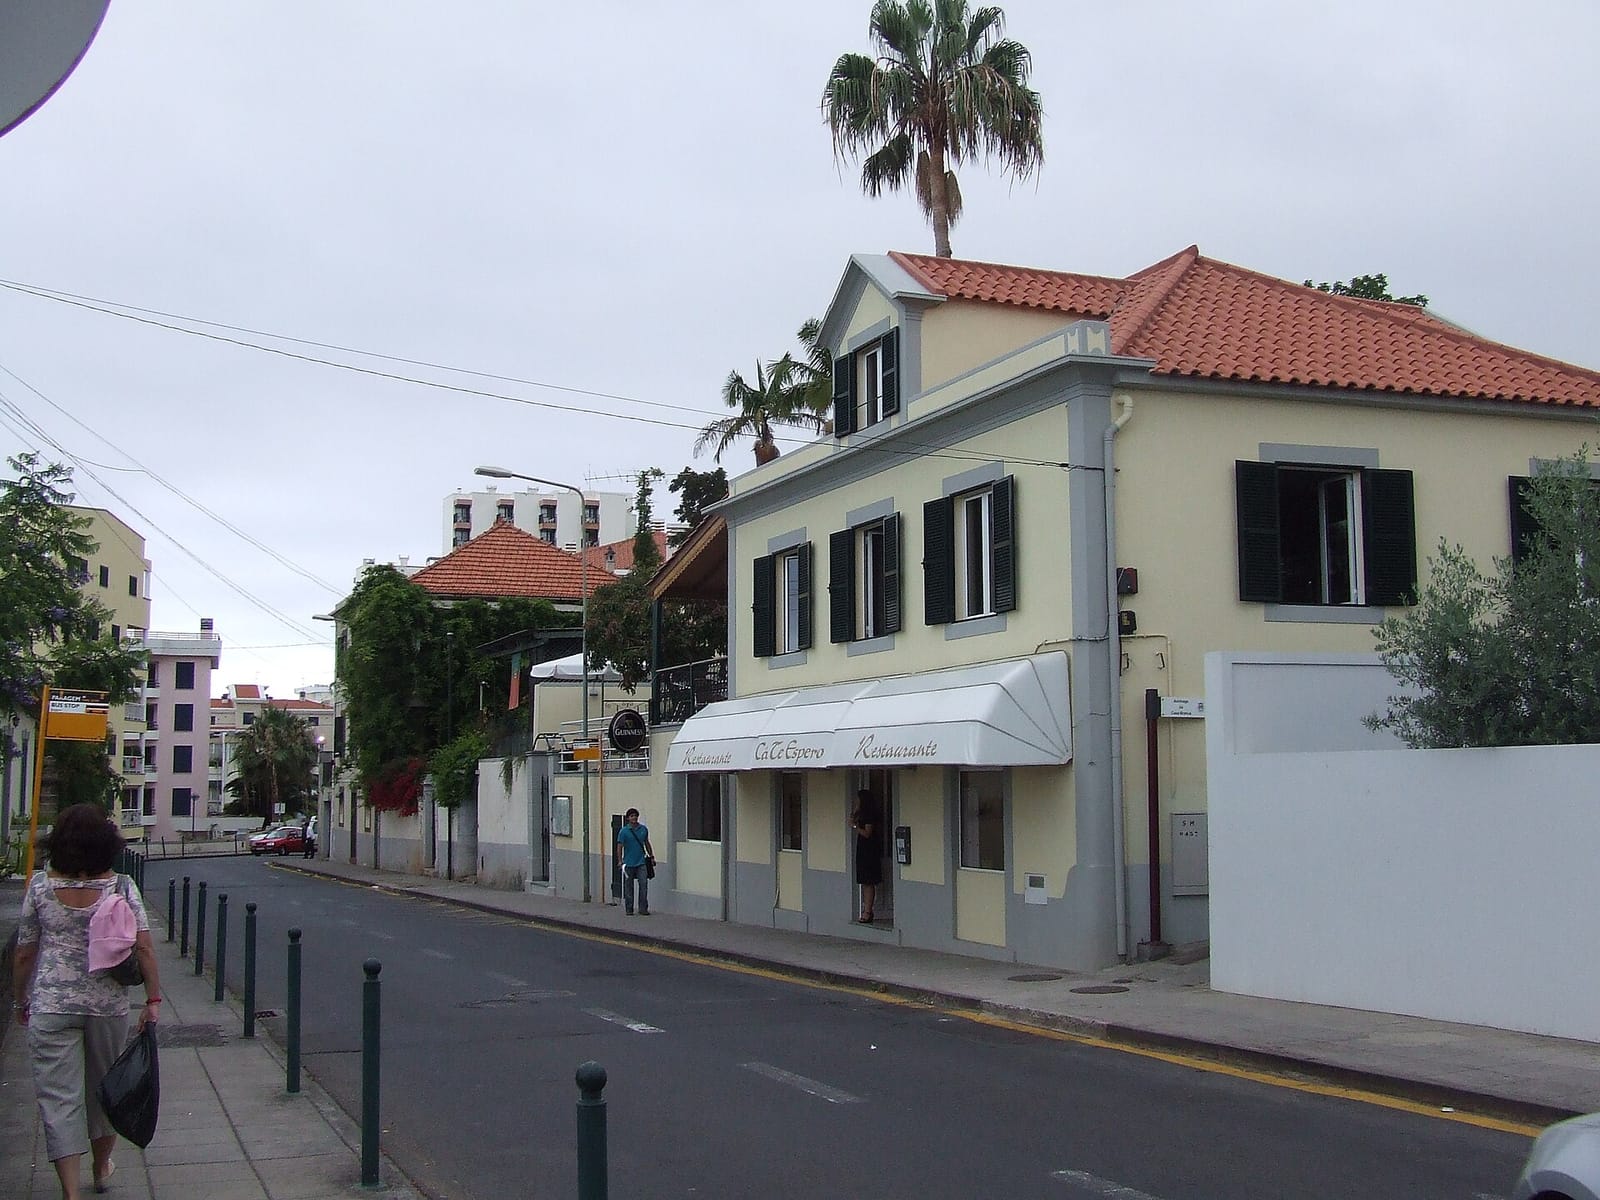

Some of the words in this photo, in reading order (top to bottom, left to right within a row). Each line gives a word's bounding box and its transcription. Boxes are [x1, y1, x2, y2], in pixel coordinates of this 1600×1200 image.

[614, 728, 643, 736] GUINNESS
[682, 745, 732, 766] Restaurante
[769, 740, 784, 760] Te
[785, 739, 825, 765] Espero
[854, 733, 938, 759] Restaurante
